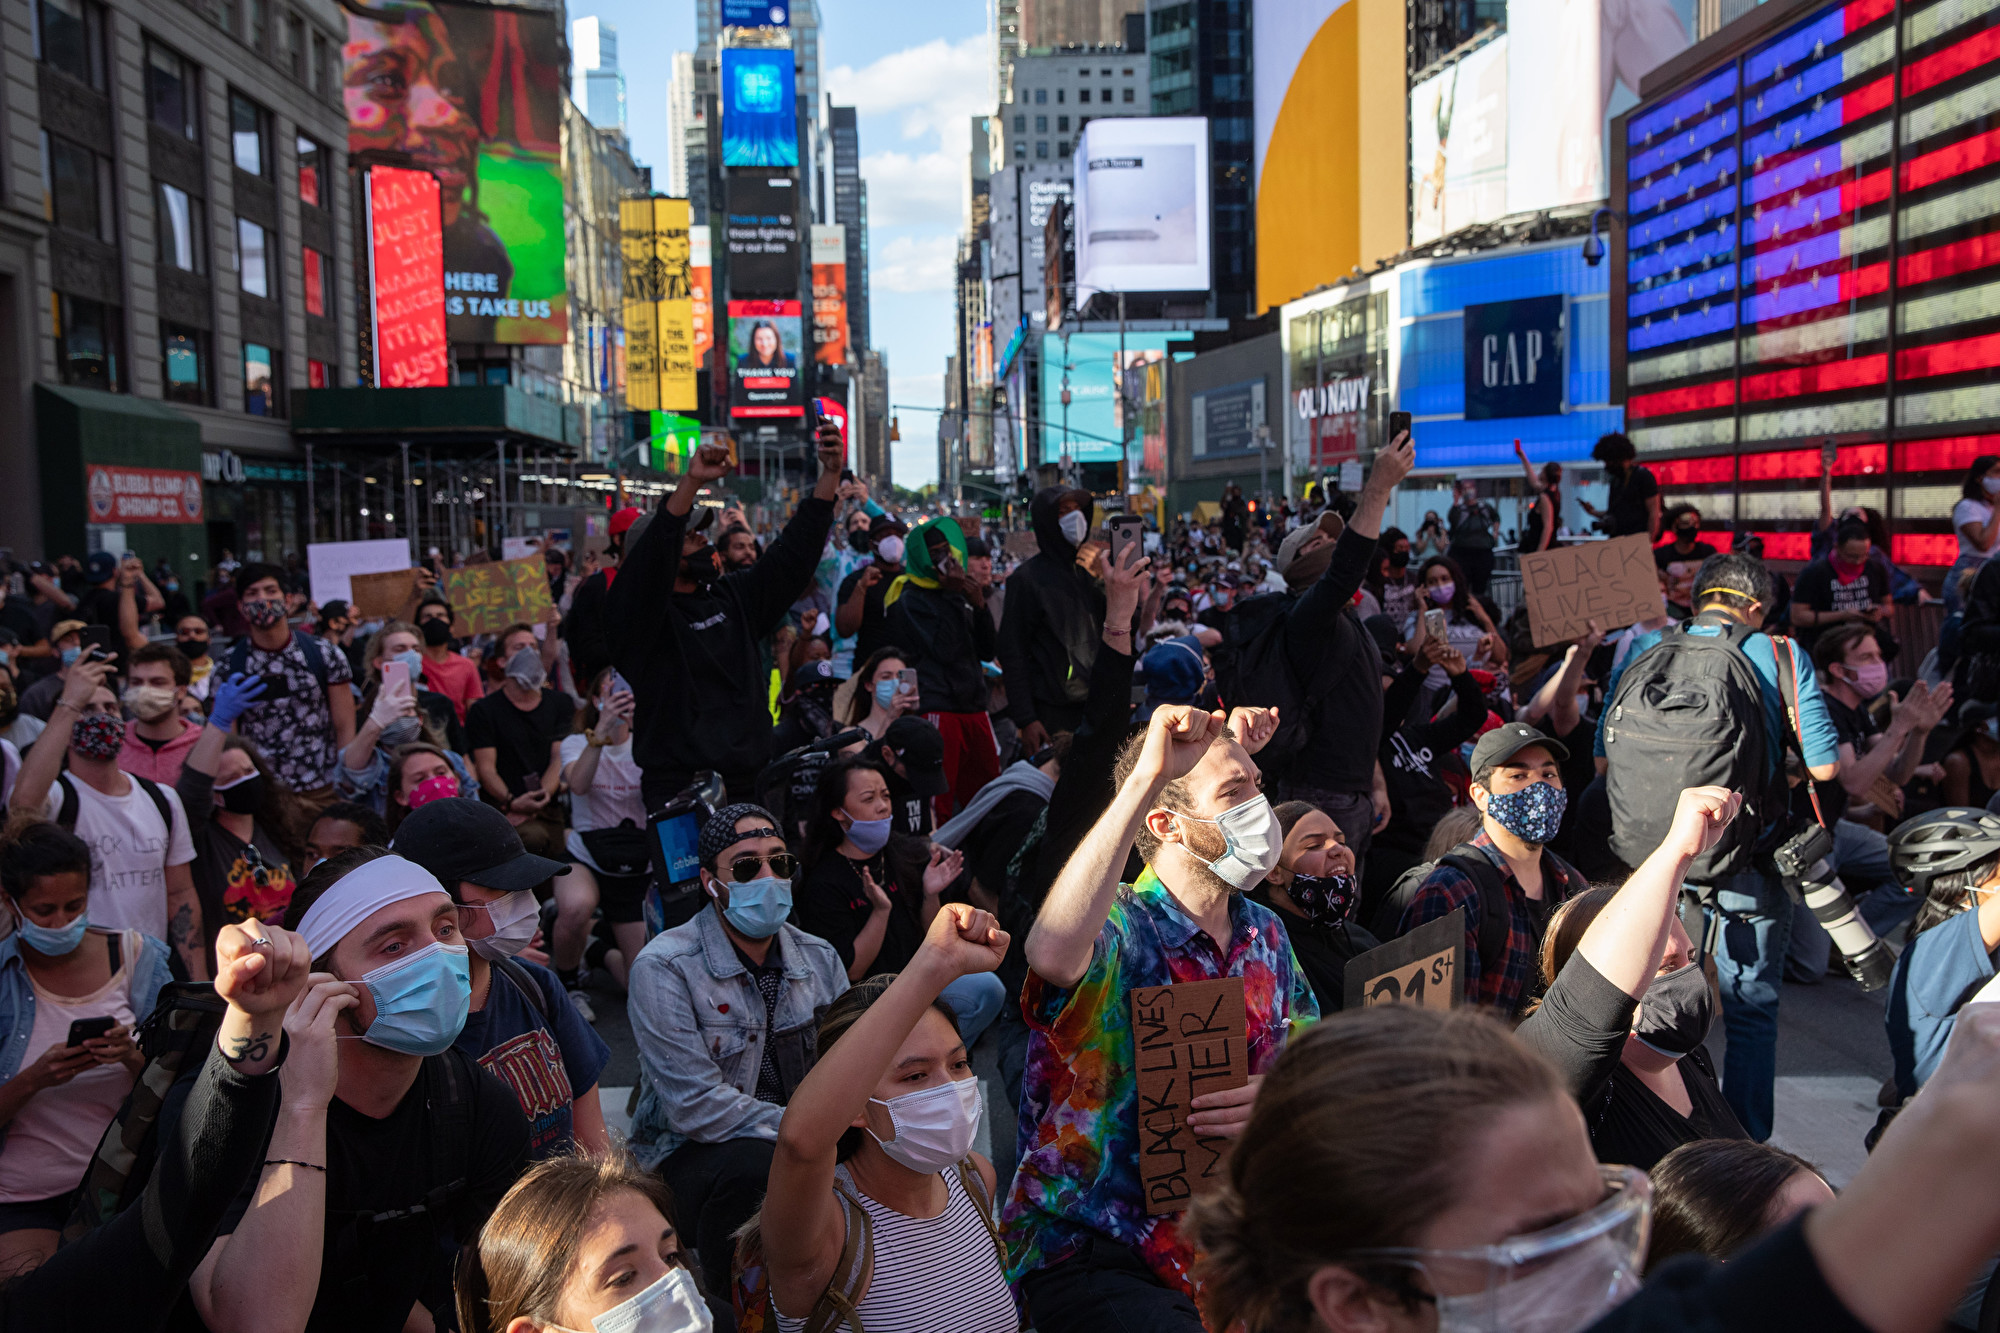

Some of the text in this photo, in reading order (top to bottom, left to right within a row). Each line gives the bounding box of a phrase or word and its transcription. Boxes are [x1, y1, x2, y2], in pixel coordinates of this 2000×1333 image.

[466, 297, 520, 317] TAKE
[523, 300, 551, 318] US
[1482, 329, 1543, 388] GAP
[1299, 376, 1371, 420] OLD NAVY
[449, 560, 546, 589] ARE YOU
[1528, 546, 1653, 594] BLACK
[1536, 580, 1635, 622] LIVES
[1539, 603, 1662, 648] MATTER
[1136, 988, 1192, 1204] BLACK LIVES
[1179, 993, 1232, 1178] MTER
